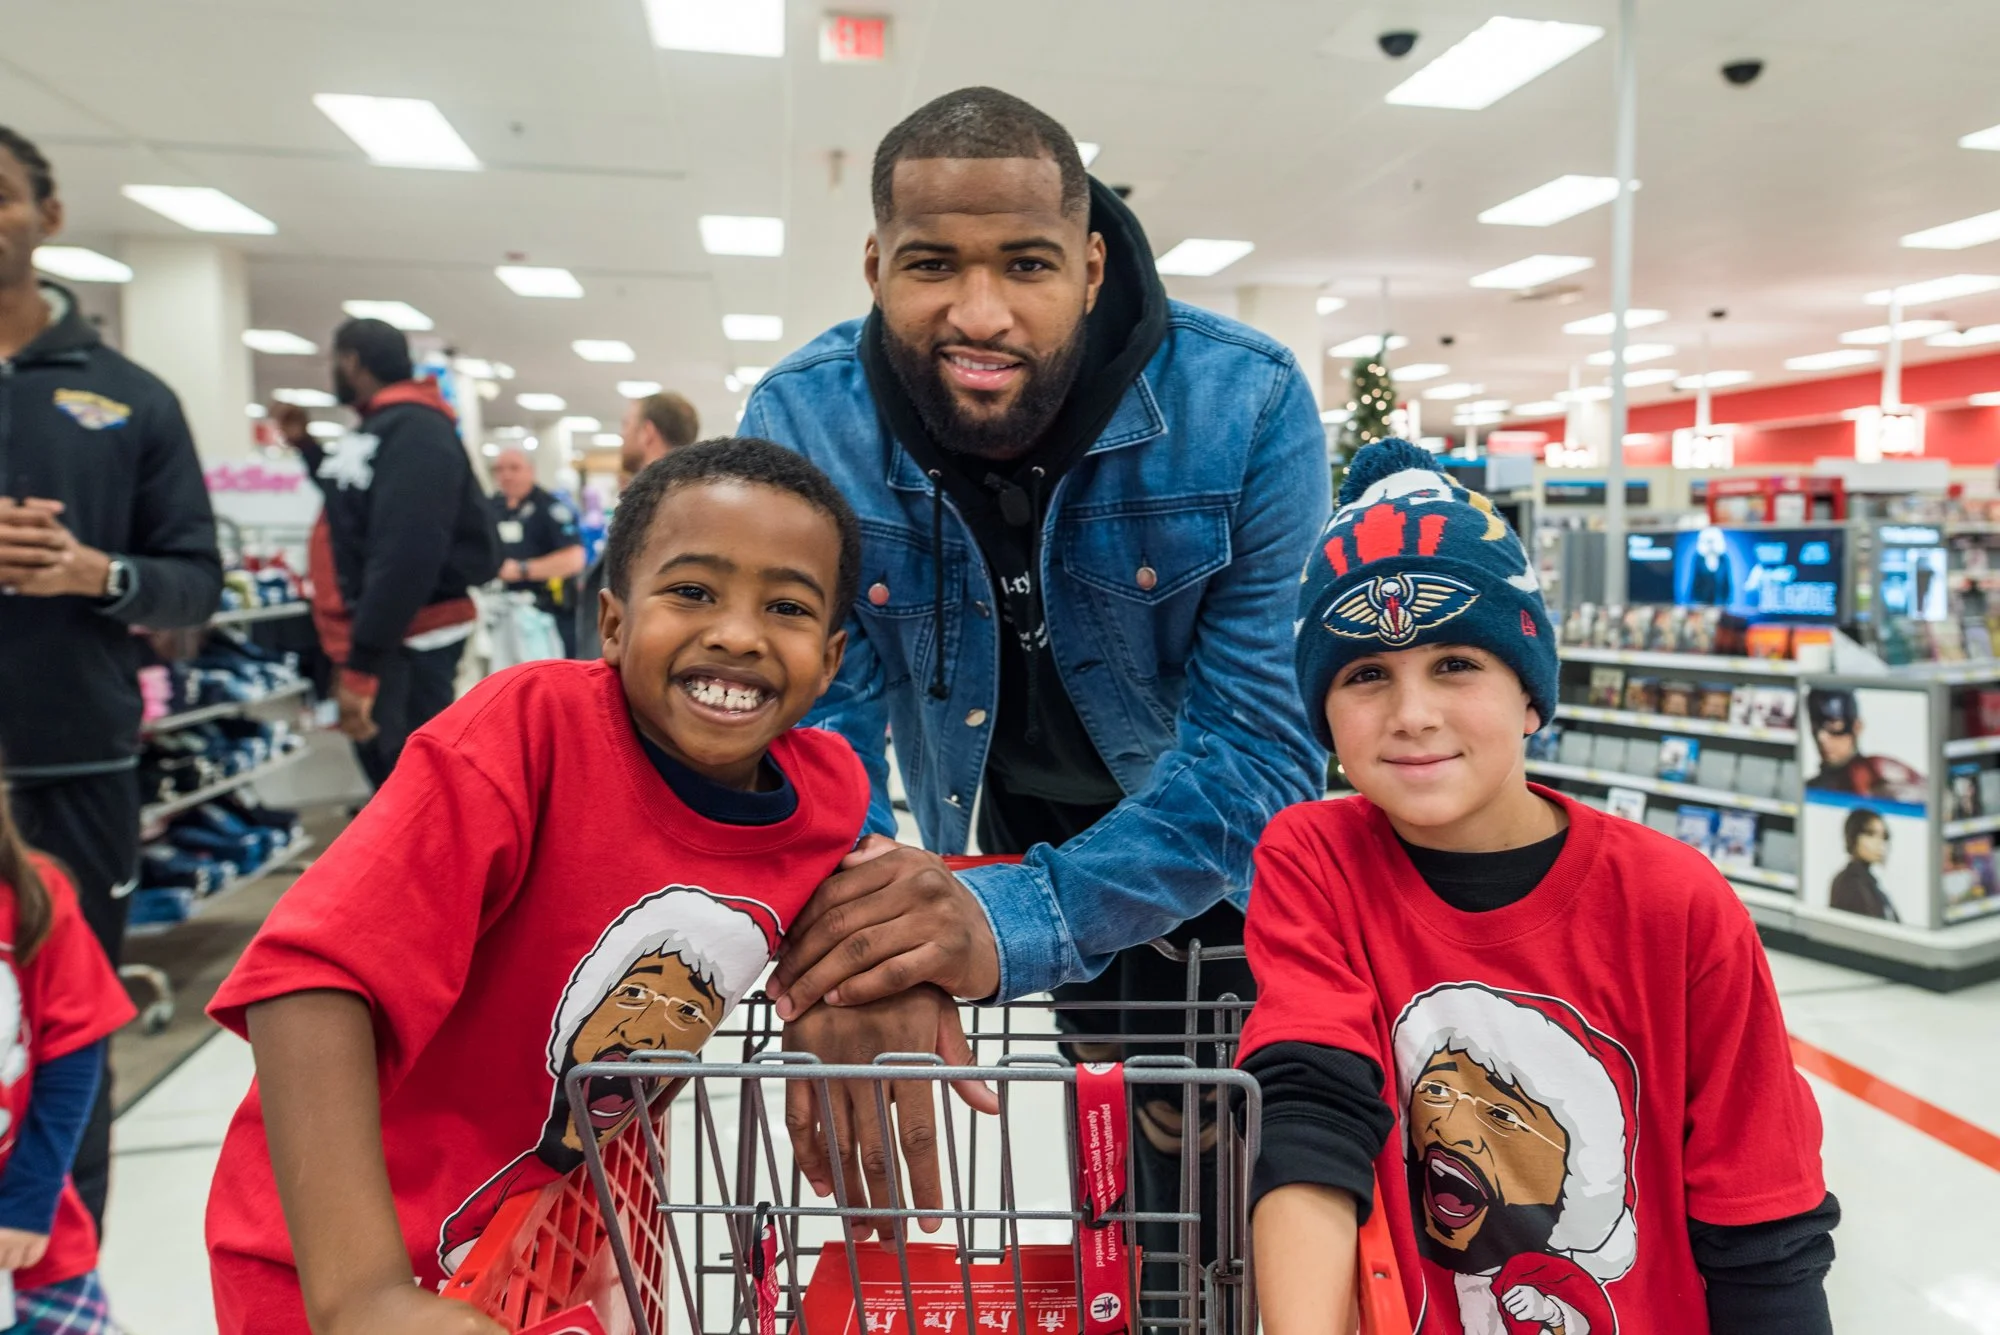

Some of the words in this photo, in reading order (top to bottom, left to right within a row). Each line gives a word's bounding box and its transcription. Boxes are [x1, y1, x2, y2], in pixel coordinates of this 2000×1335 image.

[1086, 1110, 1099, 1149] Securely
[1099, 1103, 1114, 1152] Unattended
[1091, 1149, 1102, 1172] Child
[1094, 1230, 1106, 1268] ttended
